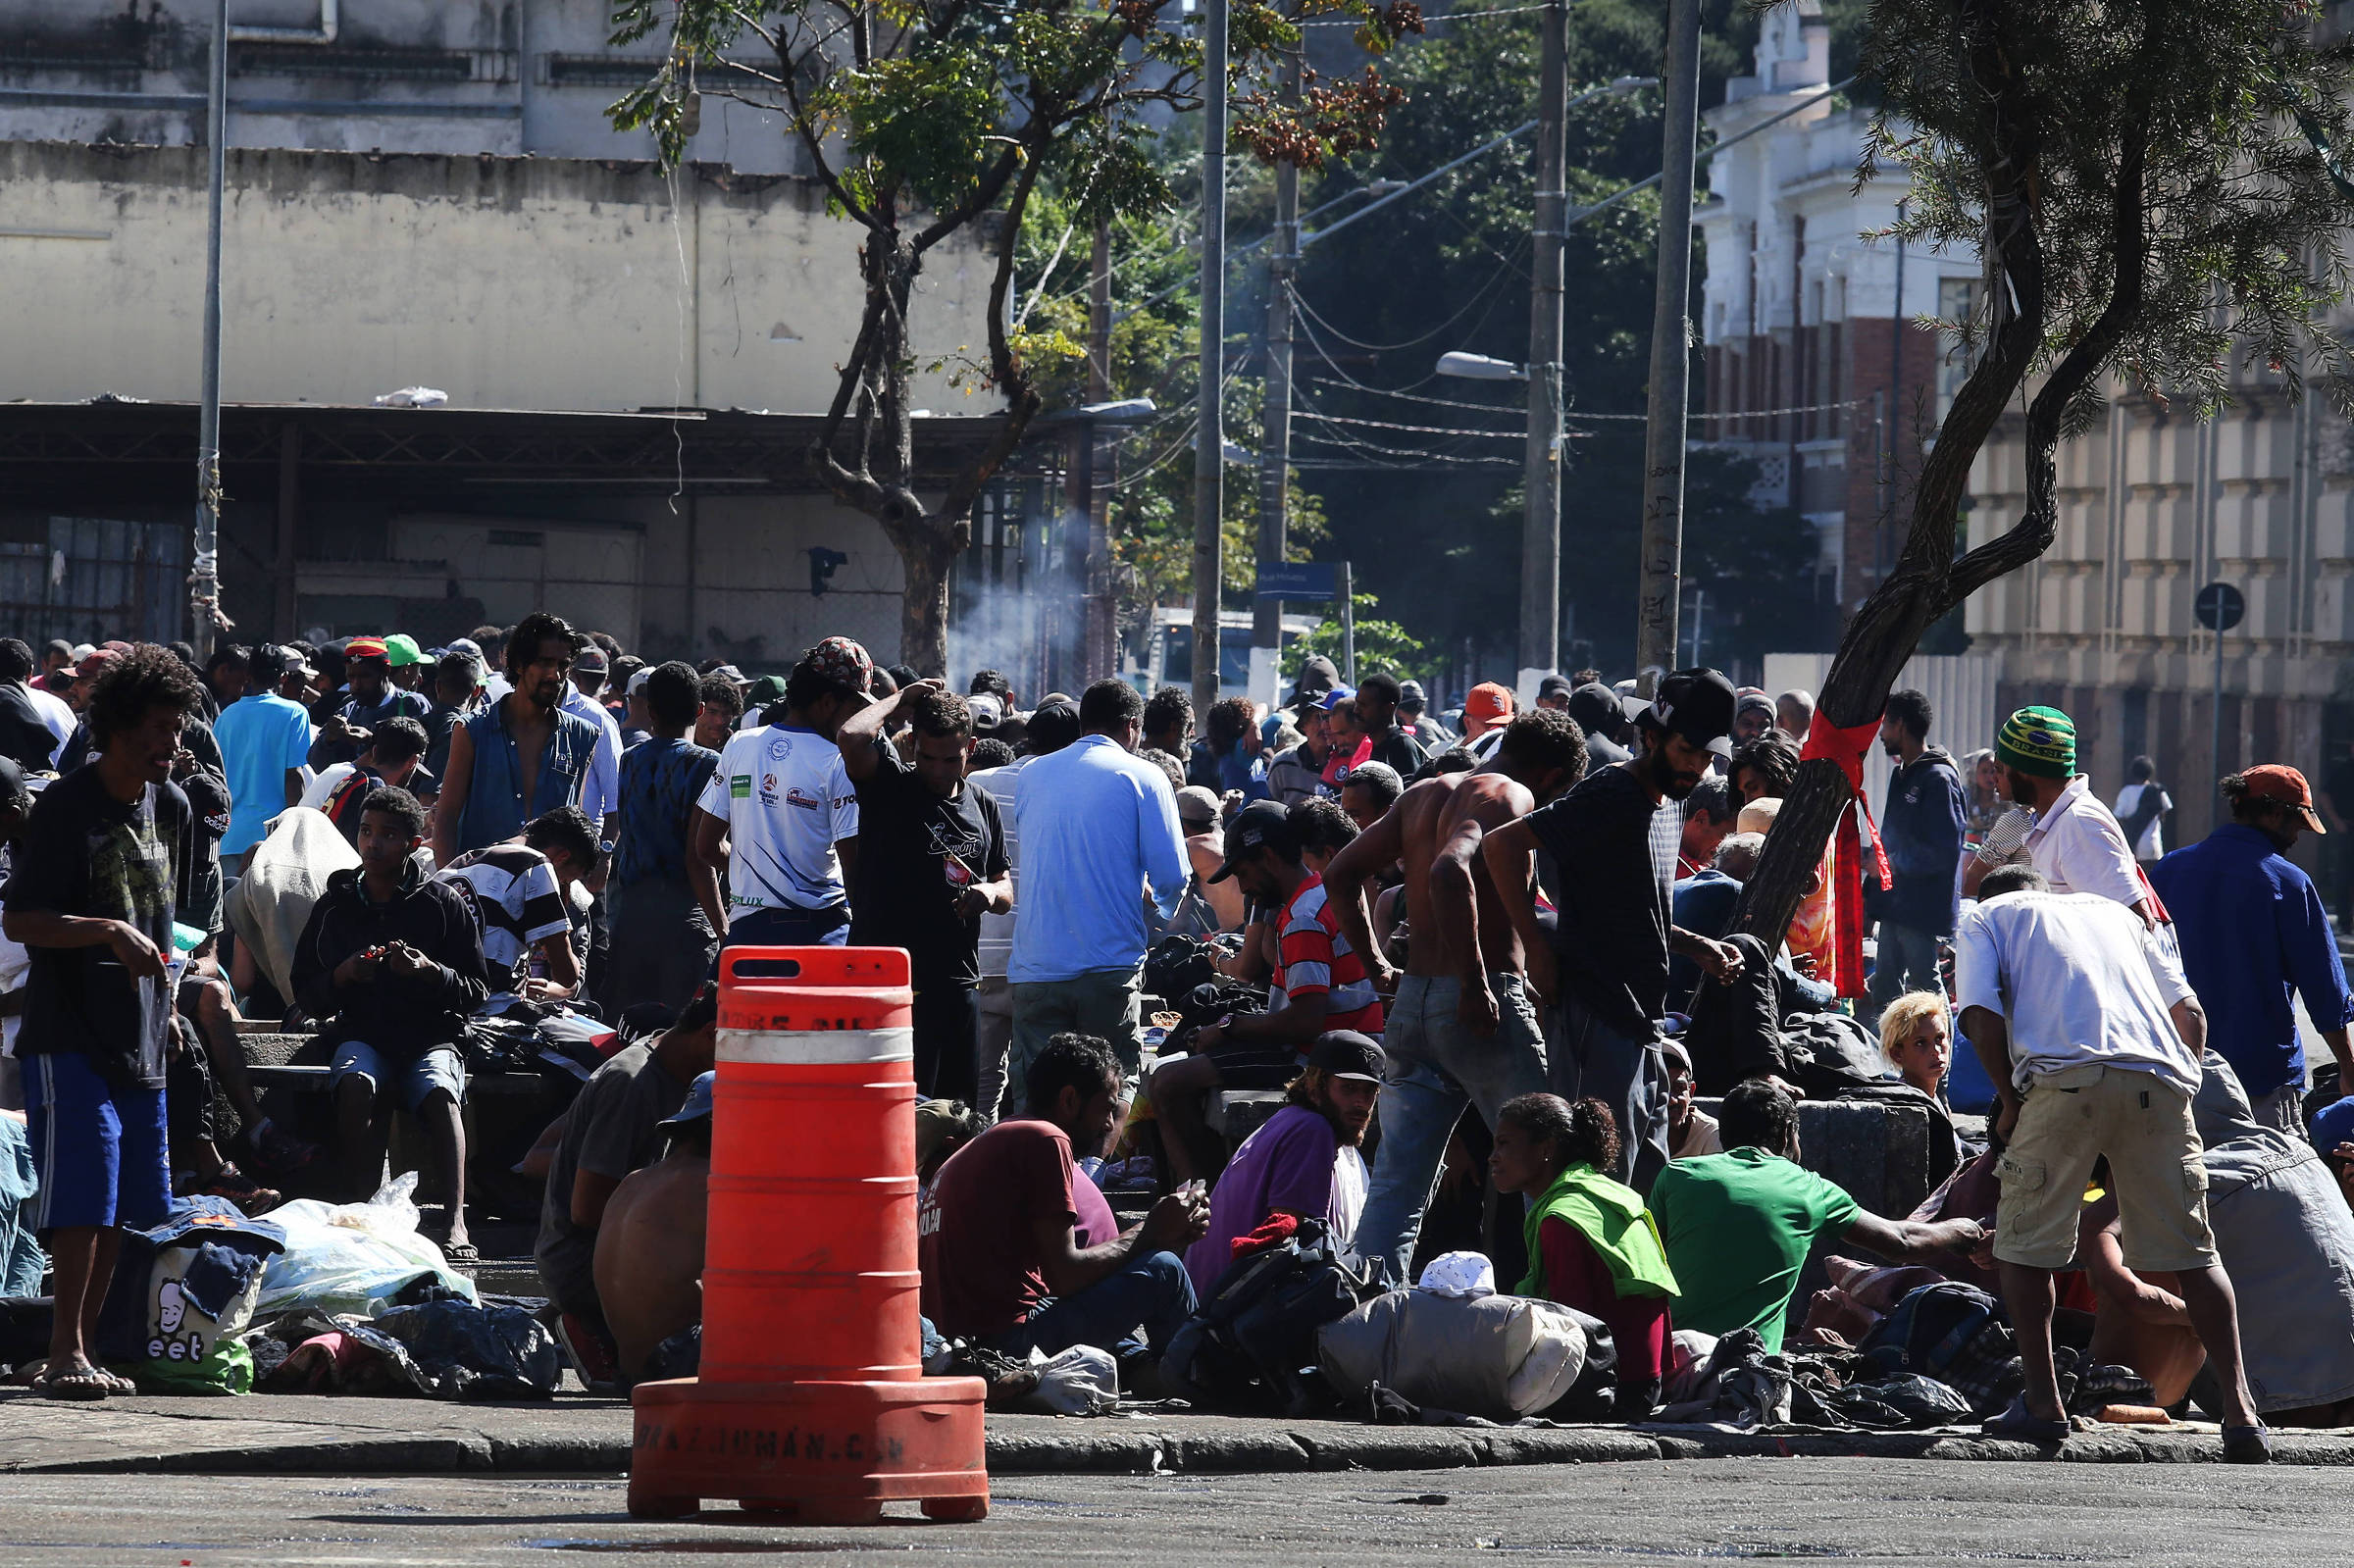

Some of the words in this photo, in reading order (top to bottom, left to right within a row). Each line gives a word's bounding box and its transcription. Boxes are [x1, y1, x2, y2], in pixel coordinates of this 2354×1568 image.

[2012, 739, 2066, 760] BRASIL
[203, 815, 229, 832] adidas
[148, 1335, 203, 1361] eet
